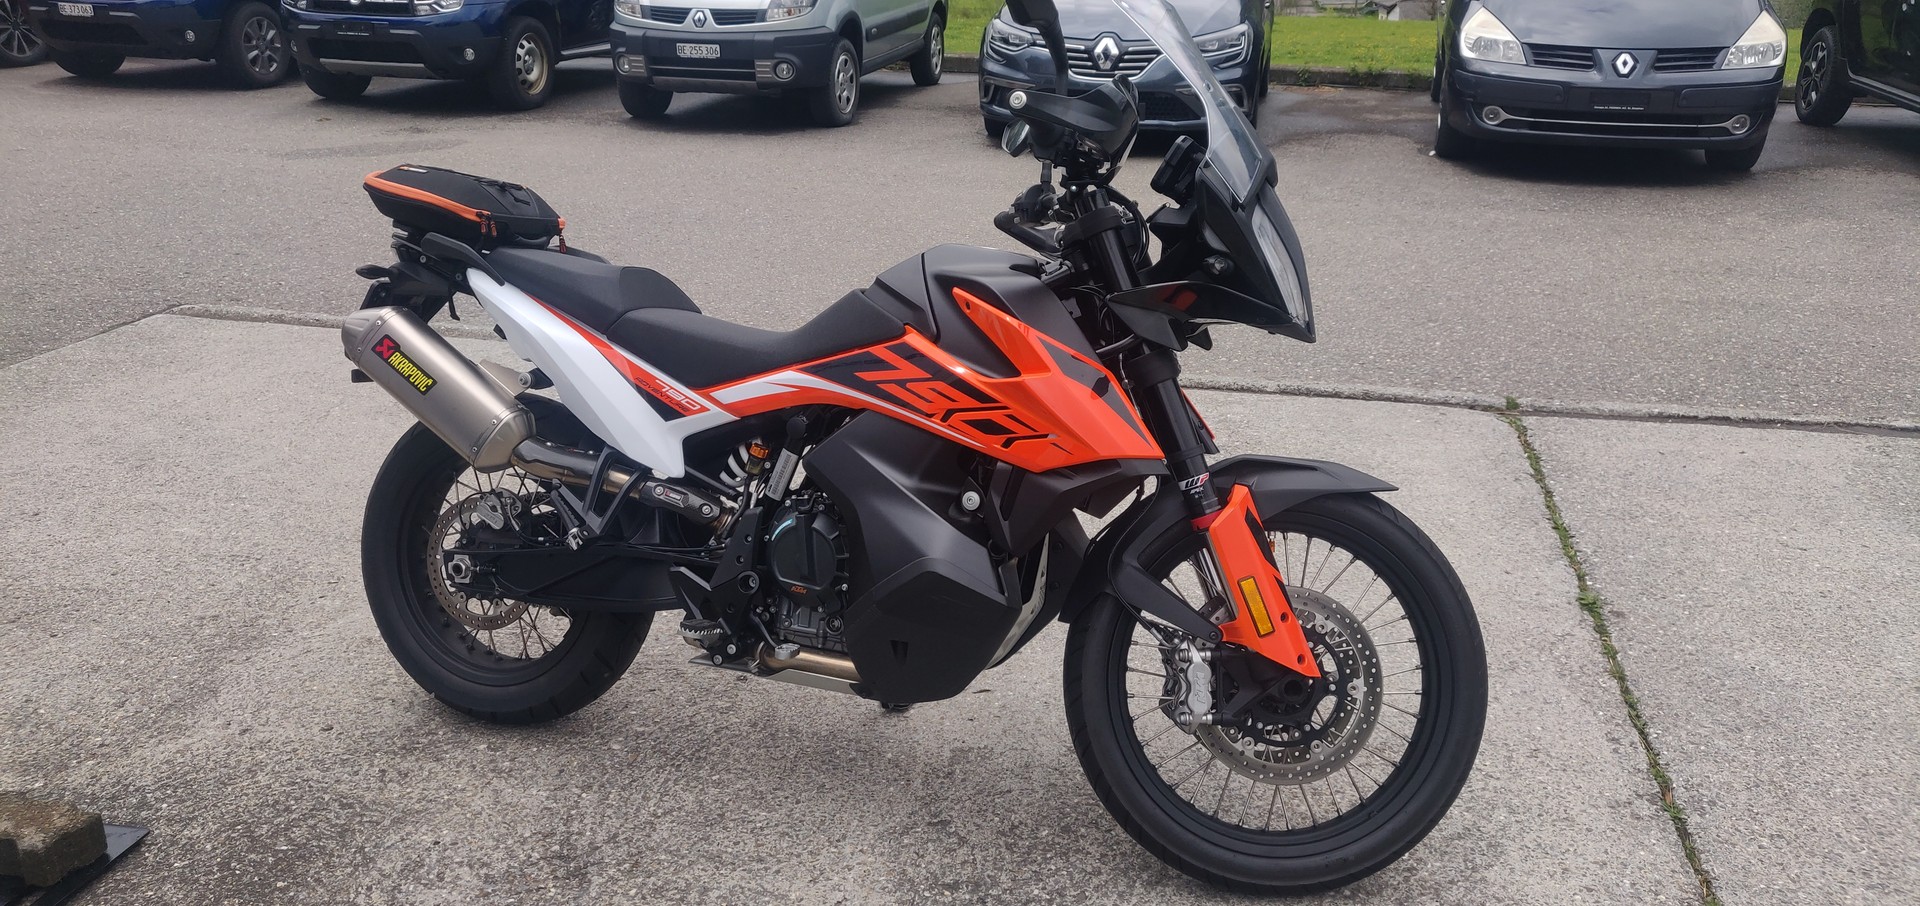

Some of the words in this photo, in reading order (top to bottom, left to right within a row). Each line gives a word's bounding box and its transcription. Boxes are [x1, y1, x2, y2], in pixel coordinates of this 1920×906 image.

[677, 45, 688, 55] BE
[655, 379, 701, 411] 790
[854, 346, 1041, 443] 790
